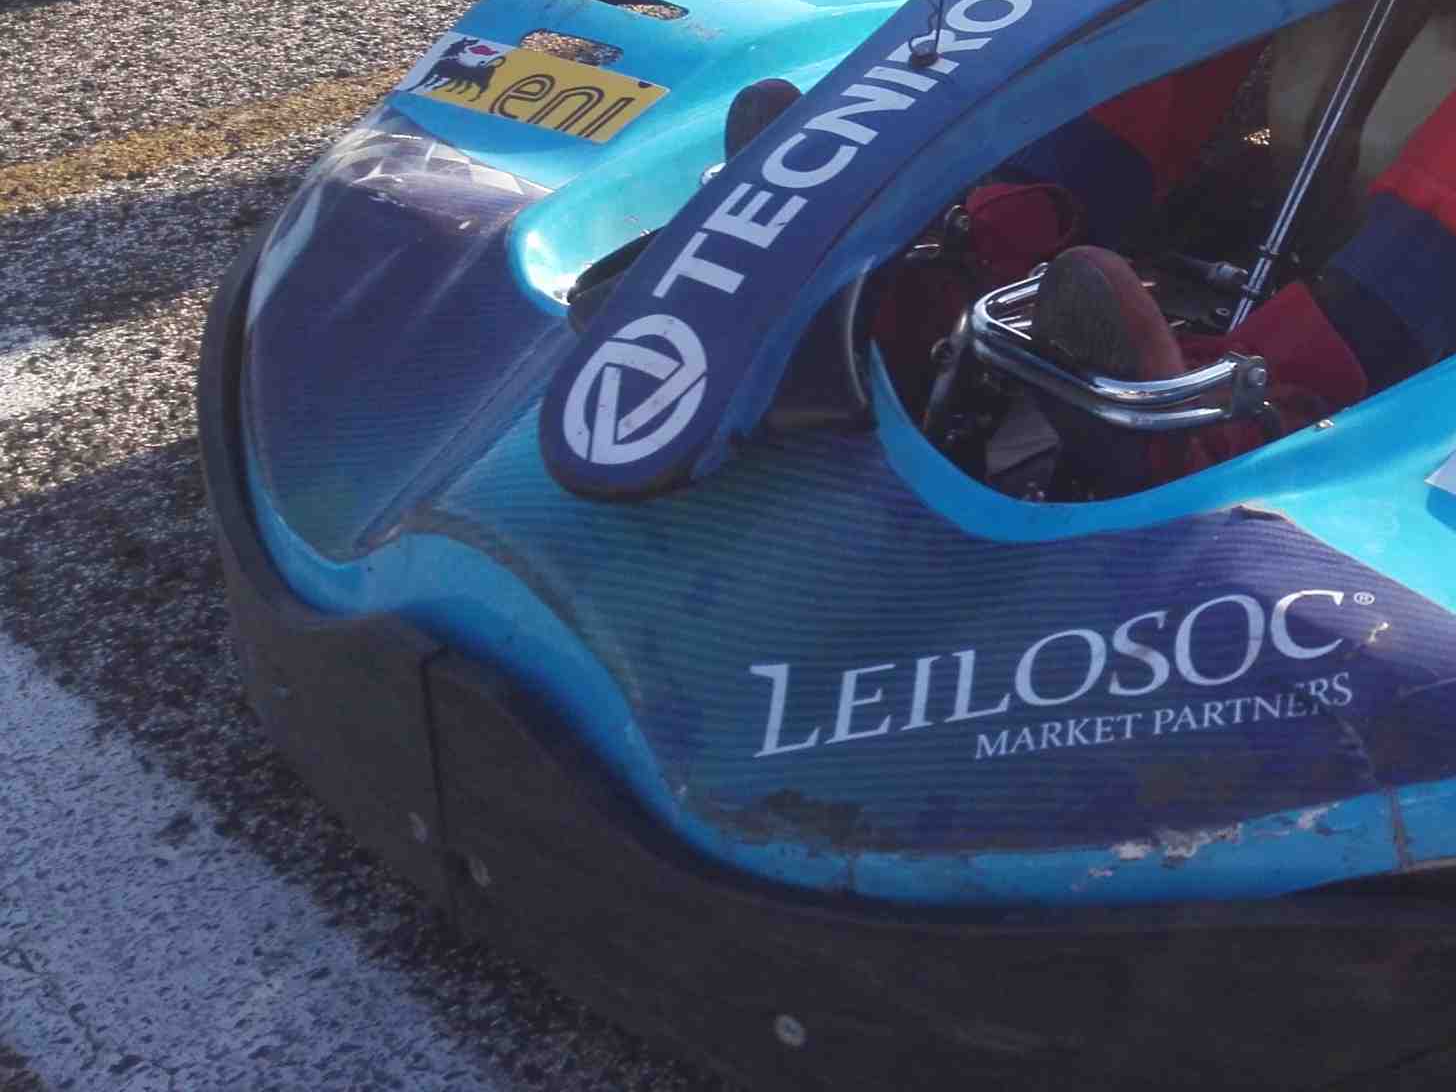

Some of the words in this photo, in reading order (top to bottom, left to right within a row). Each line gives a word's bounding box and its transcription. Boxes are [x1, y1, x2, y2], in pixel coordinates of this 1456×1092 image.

[489, 69, 655, 142] eni
[748, 589, 1345, 759] LEILOSOC
[974, 711, 1142, 760] MARKET
[1152, 670, 1354, 735] PARTNERS
